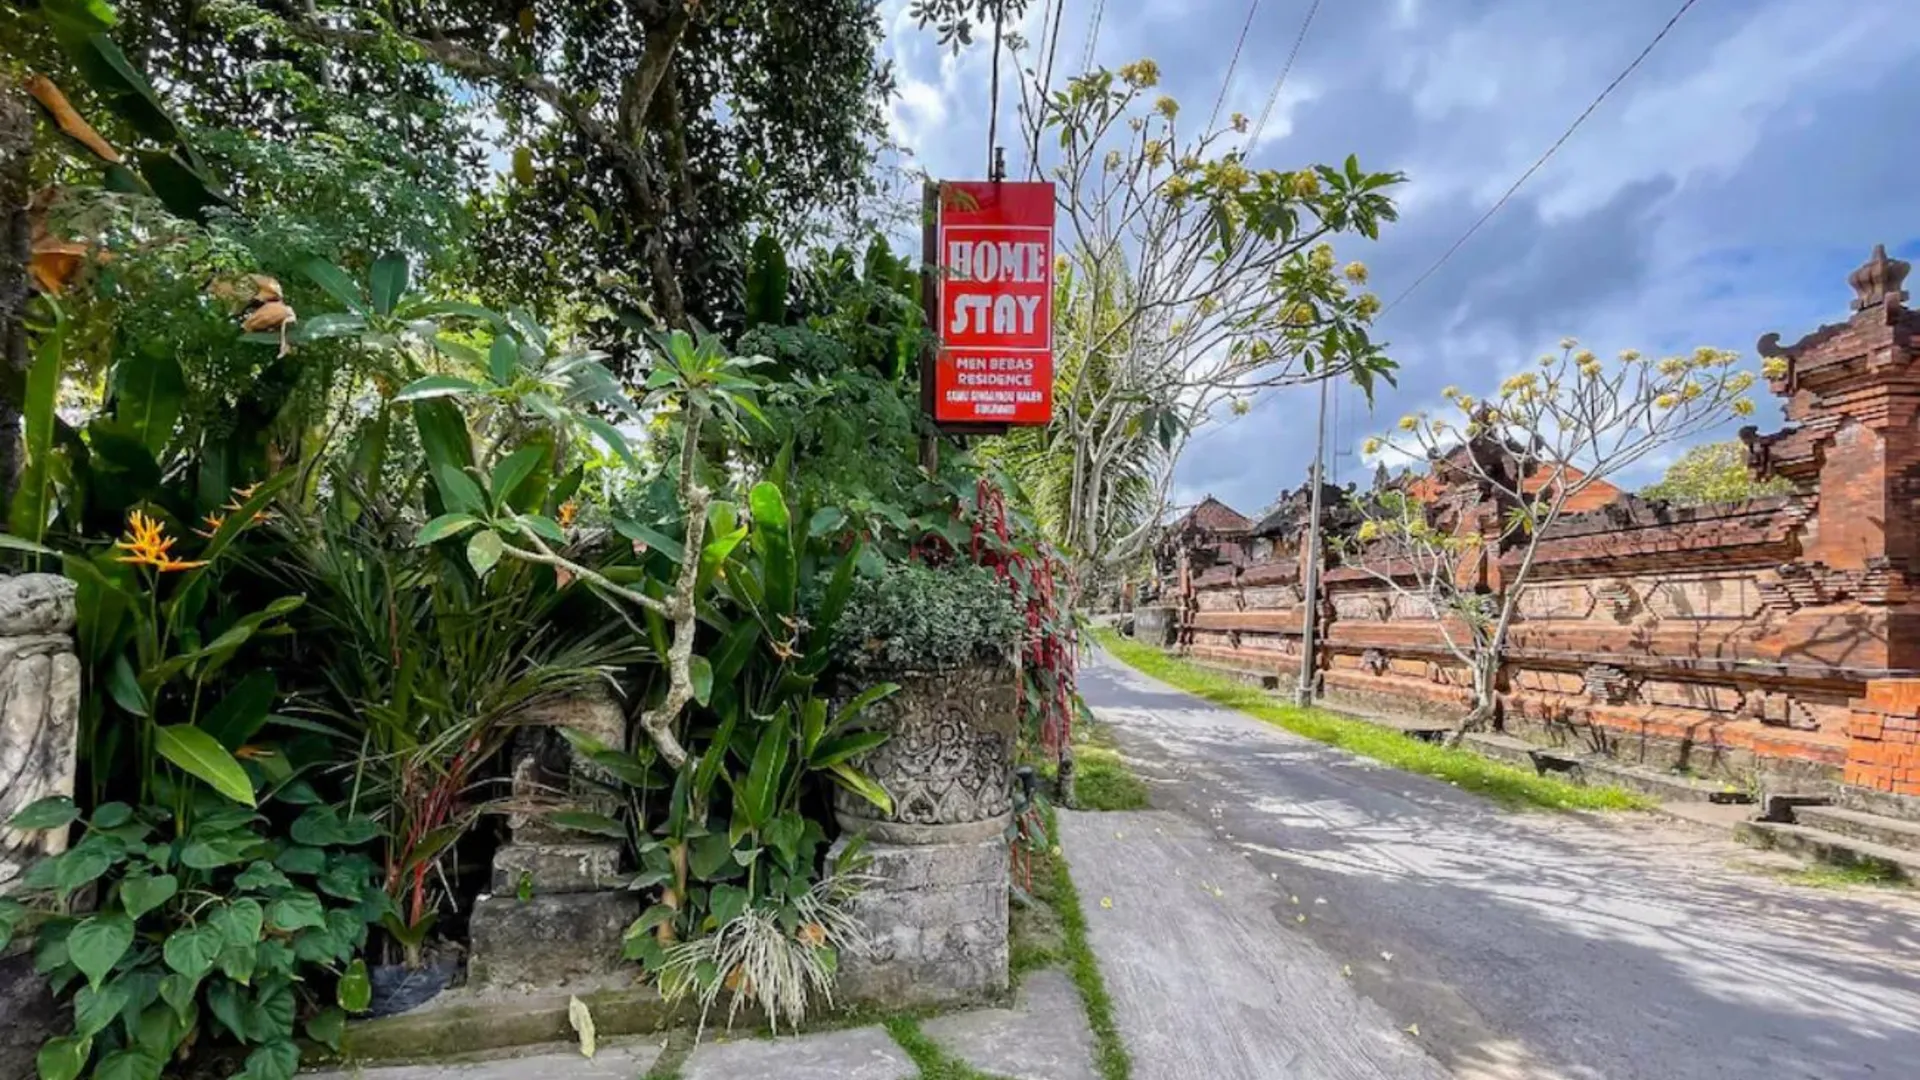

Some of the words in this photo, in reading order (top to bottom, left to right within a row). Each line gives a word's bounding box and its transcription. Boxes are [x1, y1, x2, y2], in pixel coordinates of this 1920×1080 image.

[948, 240, 1045, 282] HOME
[951, 294, 1041, 334] STAY
[956, 357, 986, 370] MEN
[989, 358, 1033, 370] BEBAS
[958, 373, 1032, 386] RESIDENCE
